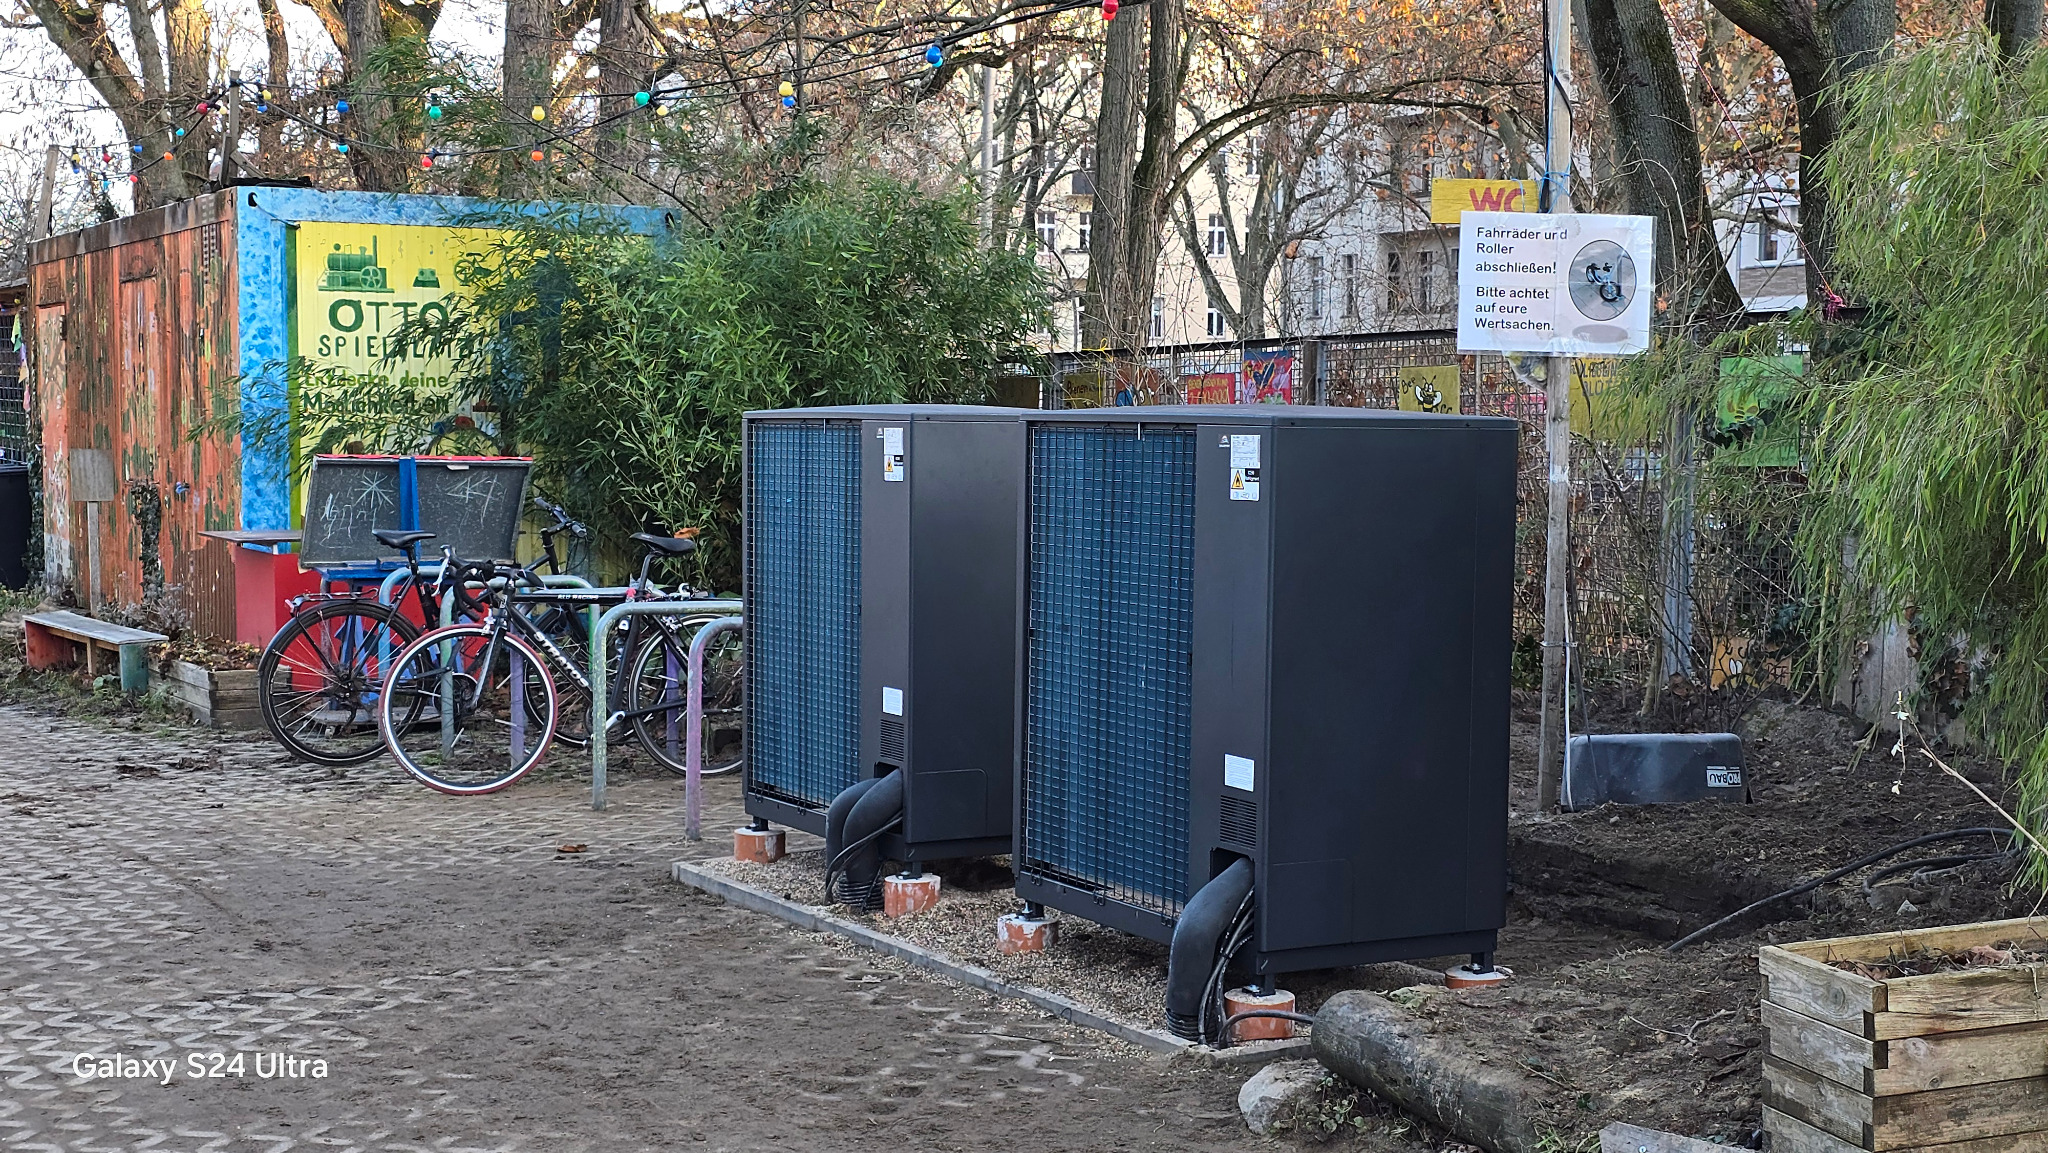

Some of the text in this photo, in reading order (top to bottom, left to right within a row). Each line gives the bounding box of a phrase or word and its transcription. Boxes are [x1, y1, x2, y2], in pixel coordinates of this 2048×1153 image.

[1468, 186, 1527, 212] WC
[1476, 227, 1541, 240] Fahrräder
[1476, 242, 1515, 255] Roller
[1475, 261, 1557, 274] abschließen!
[1476, 286, 1550, 300] Bitte achtet
[328, 298, 449, 333] OTTO
[1475, 303, 1528, 315] auf eure
[1474, 317, 1555, 331] Wertsachen.
[399, 369, 449, 388] deine
[533, 630, 590, 690] STRATOS
